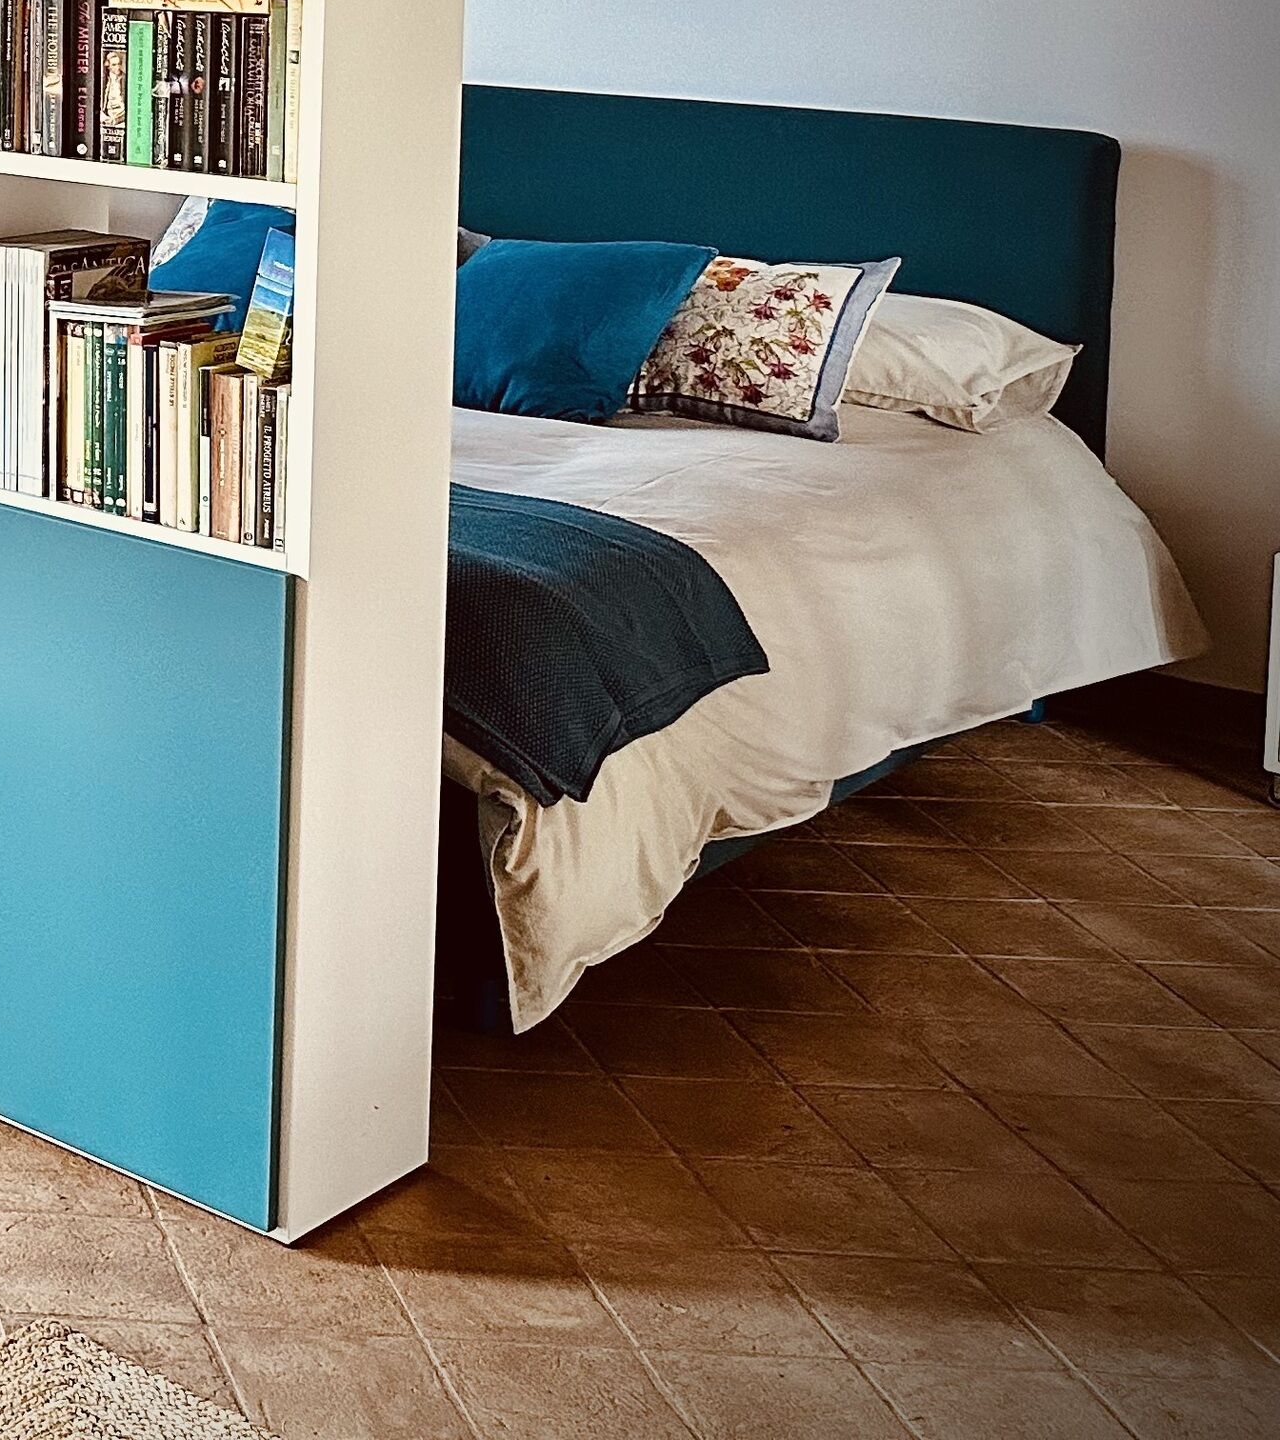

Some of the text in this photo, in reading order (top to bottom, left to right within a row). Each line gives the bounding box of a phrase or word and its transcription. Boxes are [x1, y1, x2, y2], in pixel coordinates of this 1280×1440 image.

[48, 5, 58, 29] THE
[104, 23, 127, 32] JAMES
[77, 1, 91, 74] The MISTER
[103, 33, 127, 43] COOK
[78, 102, 86, 133] James
[262, 425, 272, 513] IL PROGETTO ATREUS
